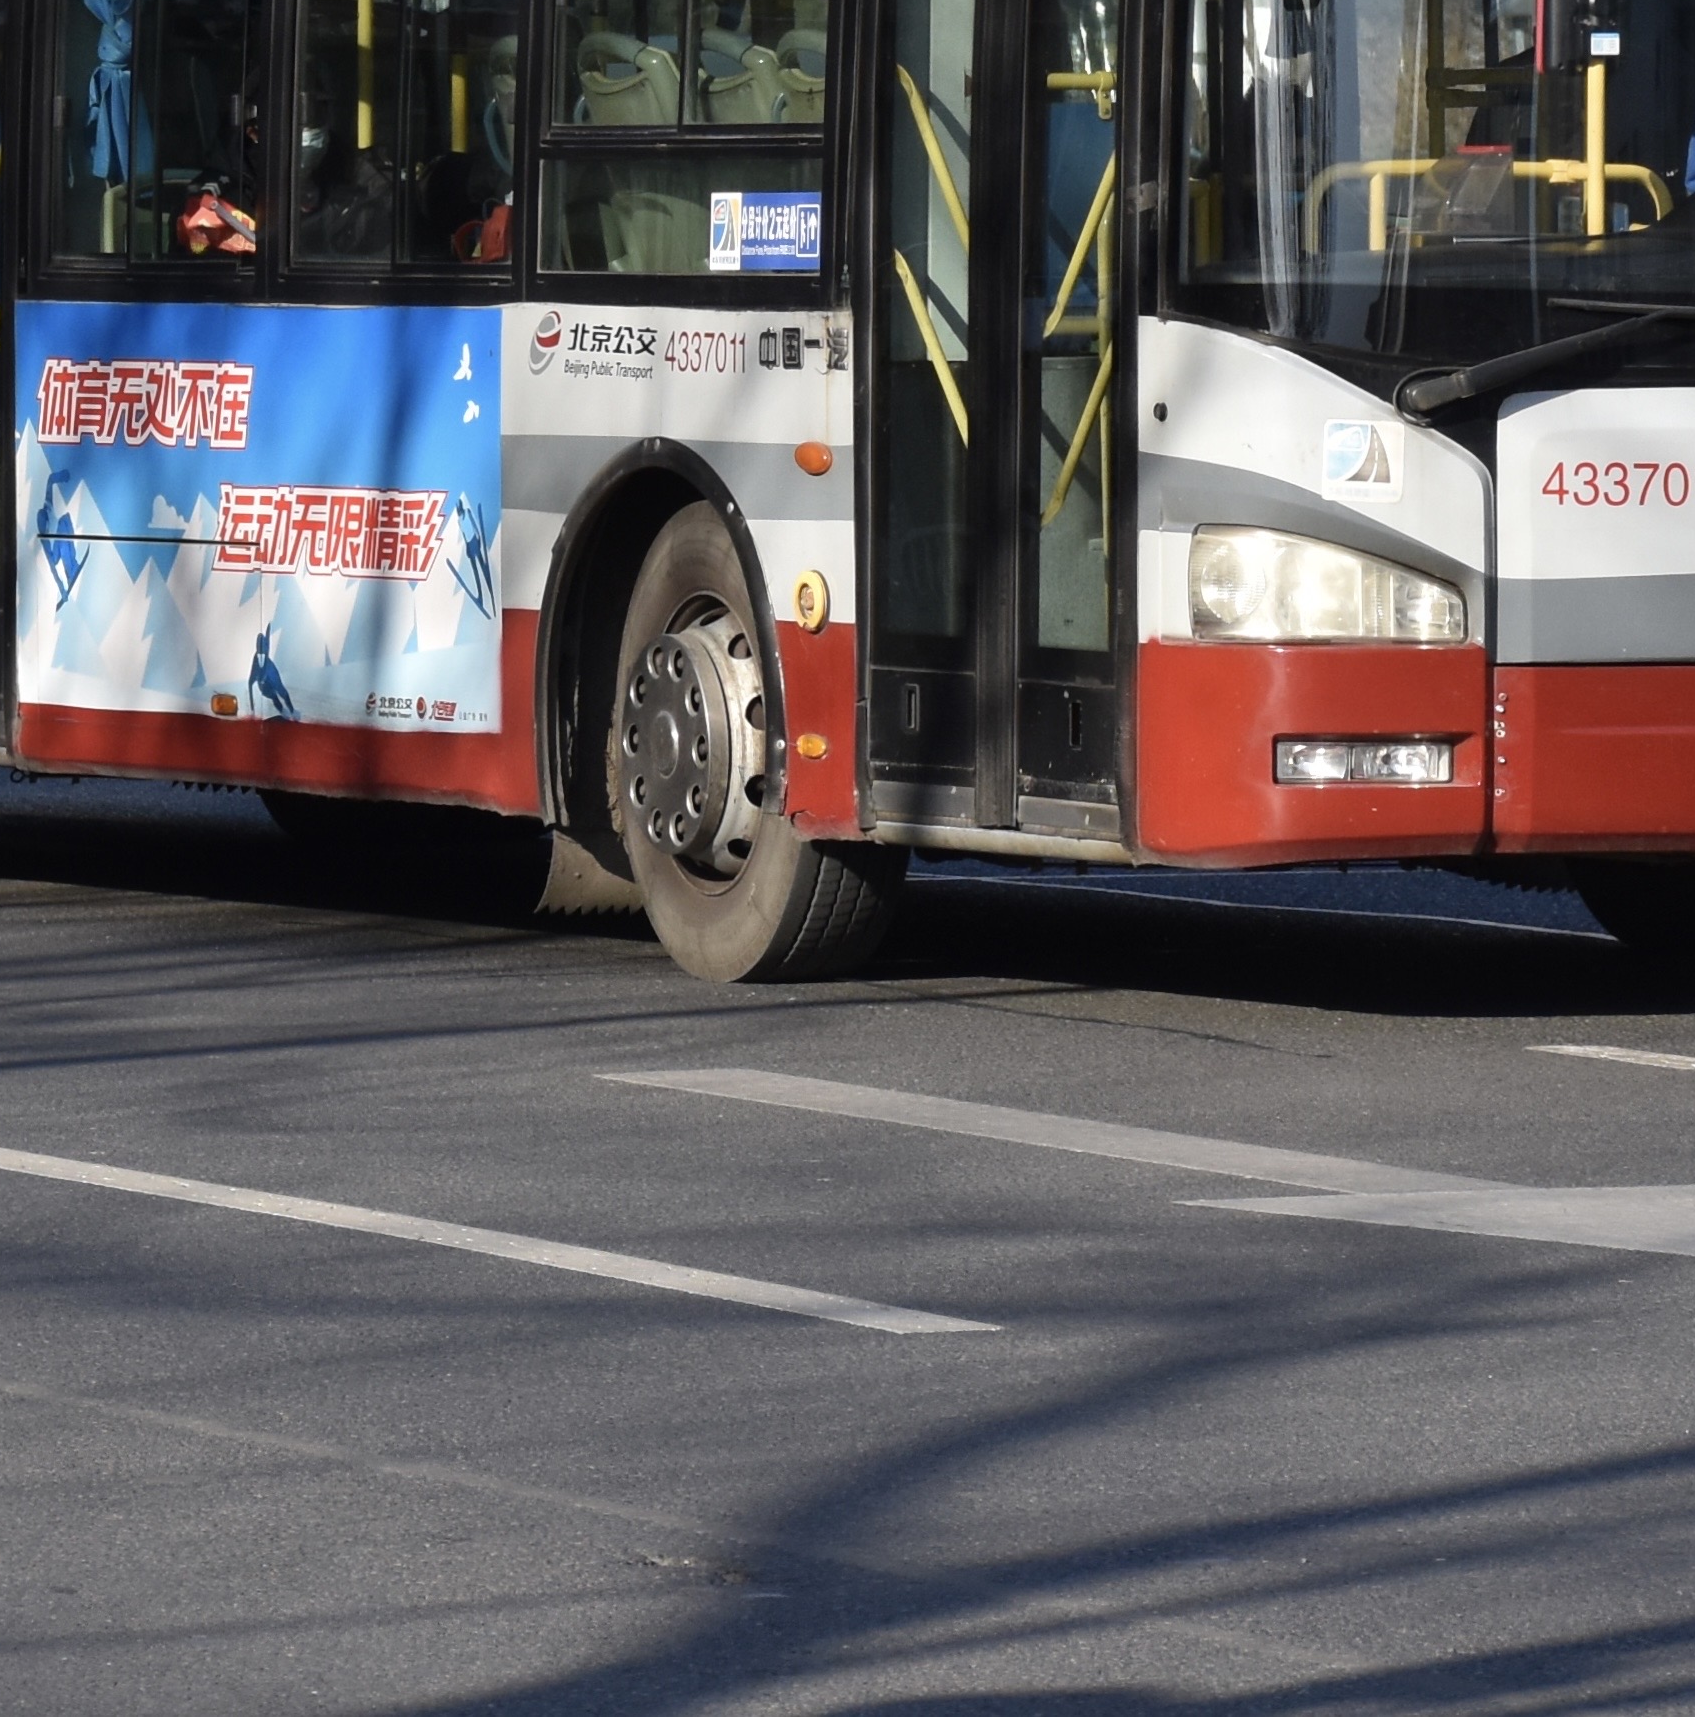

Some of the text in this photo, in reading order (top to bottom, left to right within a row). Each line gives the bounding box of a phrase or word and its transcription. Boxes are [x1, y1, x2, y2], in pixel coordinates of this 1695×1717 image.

[567, 323, 658, 356] 北京公交
[665, 330, 747, 374] 4337011
[563, 359, 654, 381] Beijing Public Transport
[38, 358, 252, 449] 体育无处不在
[214, 486, 446, 579] 运动无限精彩
